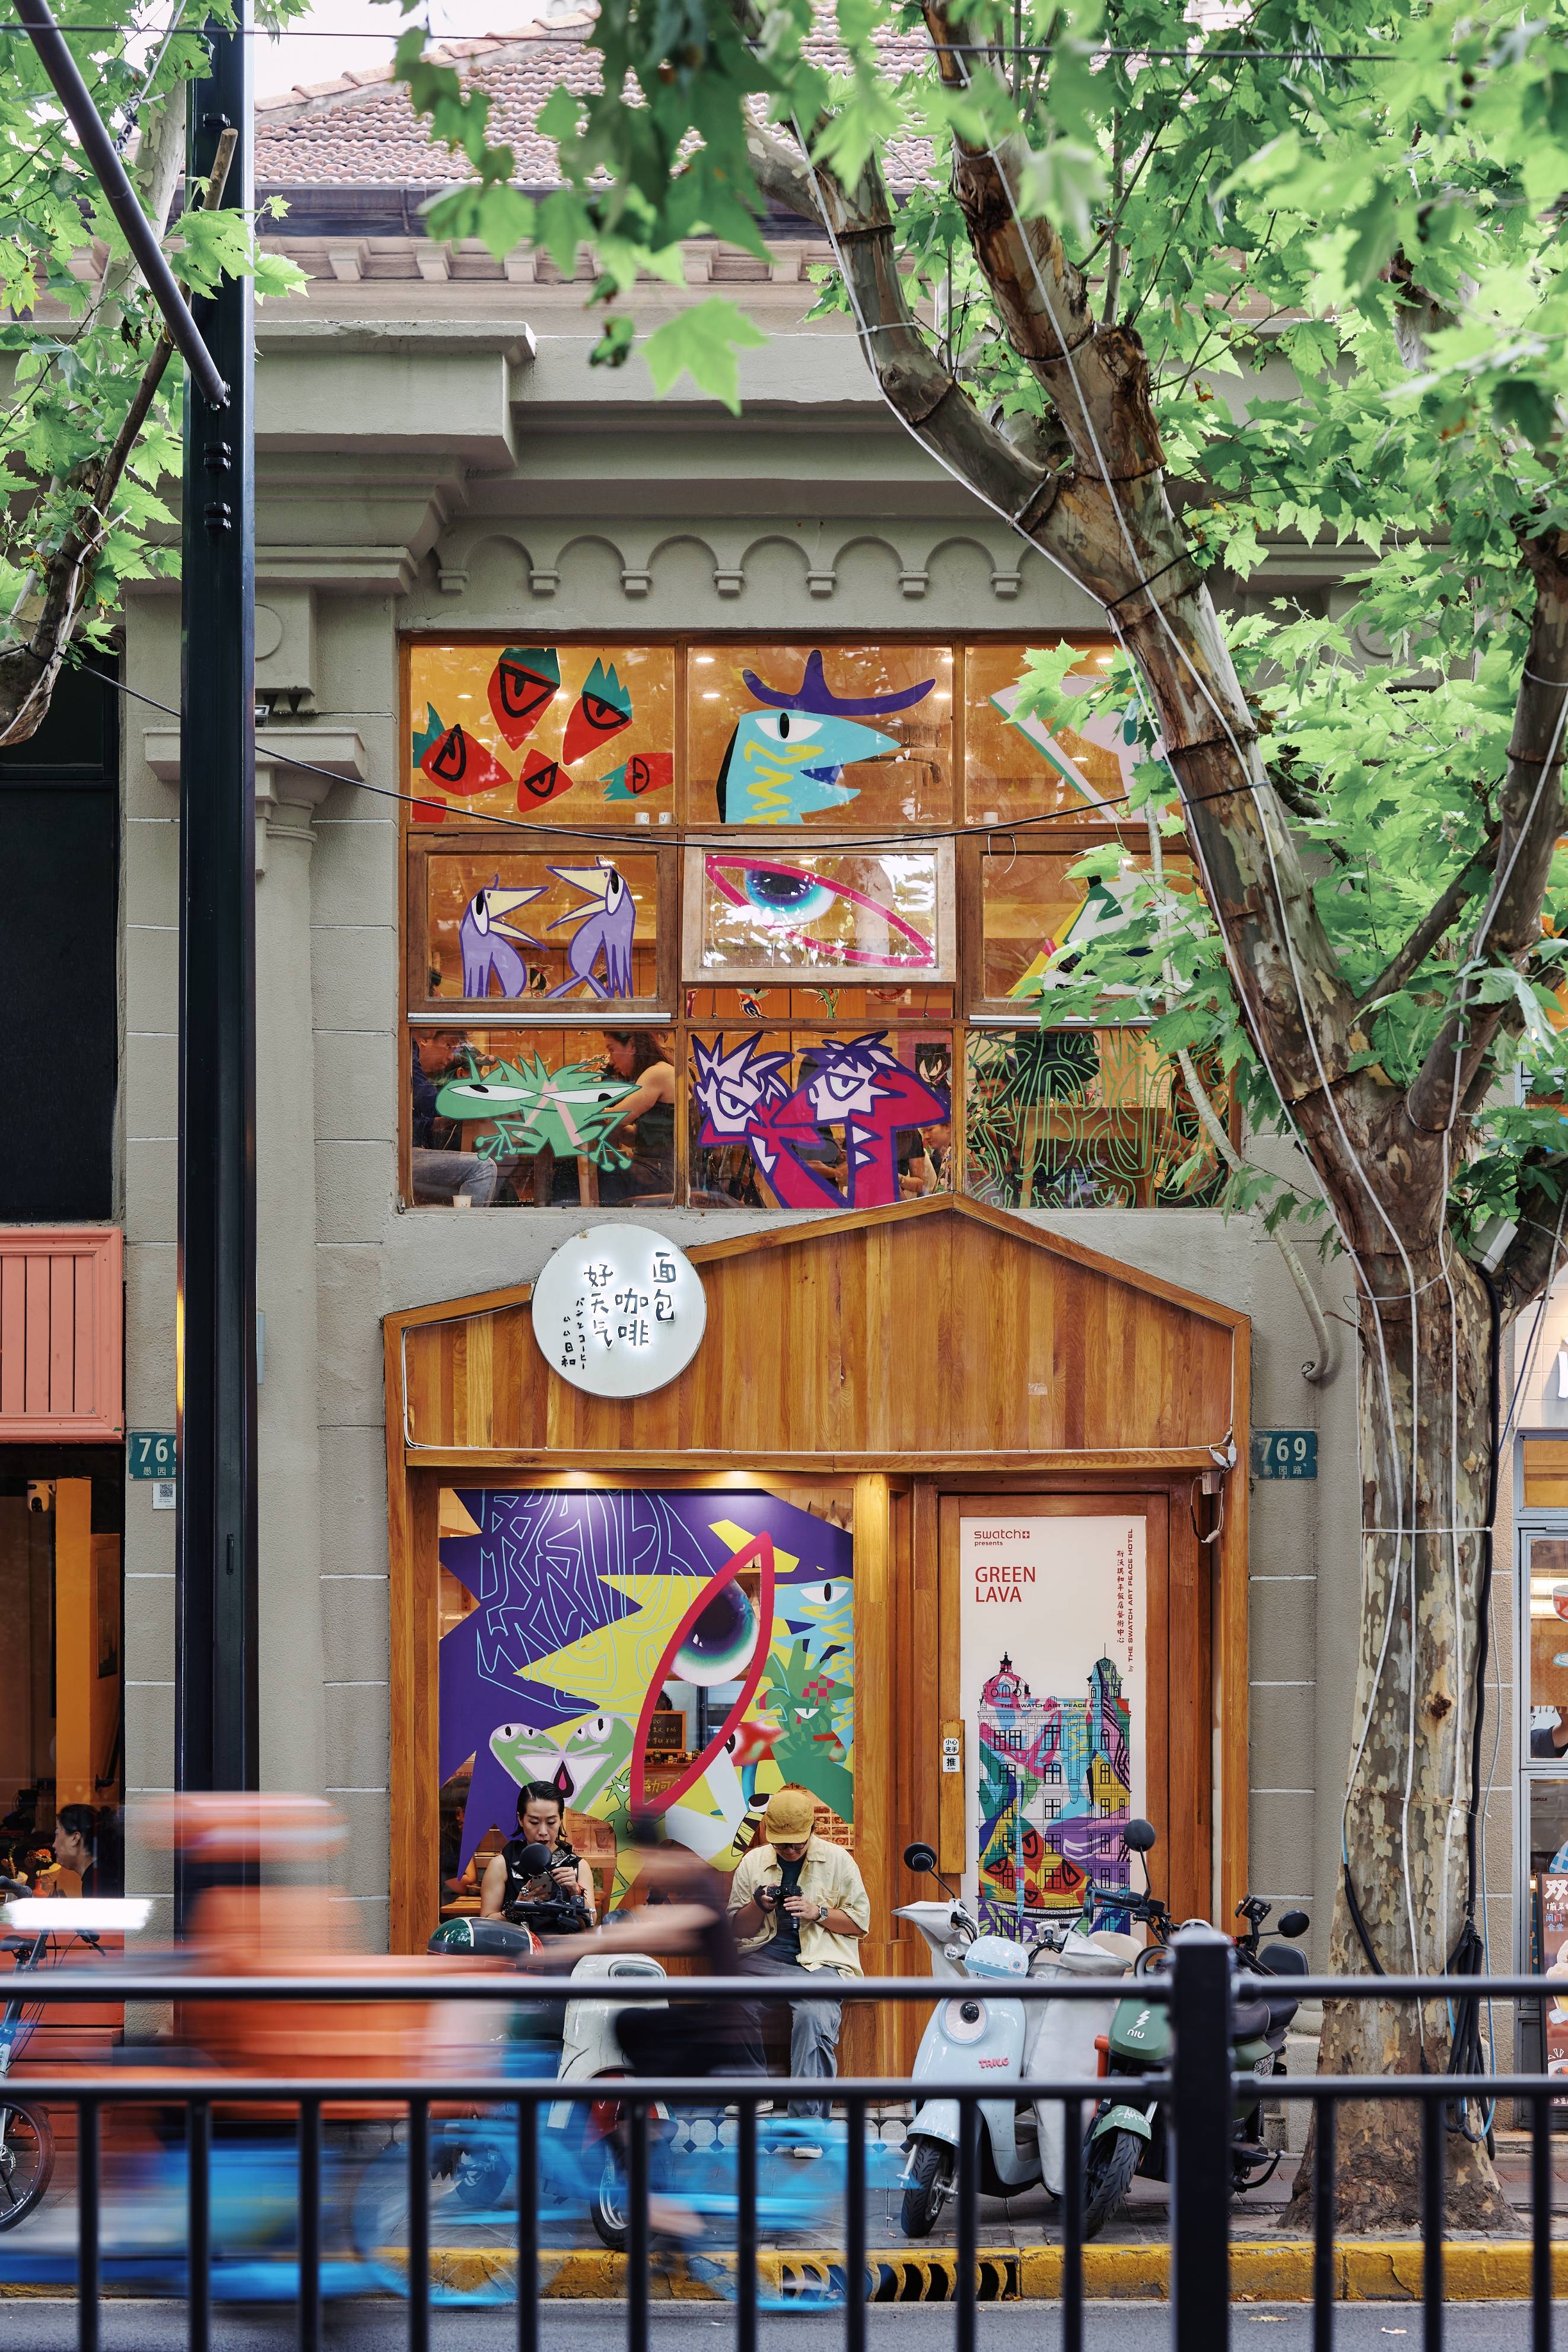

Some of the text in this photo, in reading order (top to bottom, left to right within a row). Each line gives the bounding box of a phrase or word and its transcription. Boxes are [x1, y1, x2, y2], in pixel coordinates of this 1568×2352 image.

[653, 1251, 676, 1321] 面包
[584, 1264, 613, 1347] 好天气
[615, 1288, 649, 1346] 咖啡
[139, 1438, 176, 1463] 76
[1258, 1437, 1306, 1461] 769
[974, 1530, 1021, 1539] swatch
[975, 1566, 1035, 1582] GREEN
[976, 1587, 1022, 1602] LAVA
[947, 1757, 956, 1766] 推
